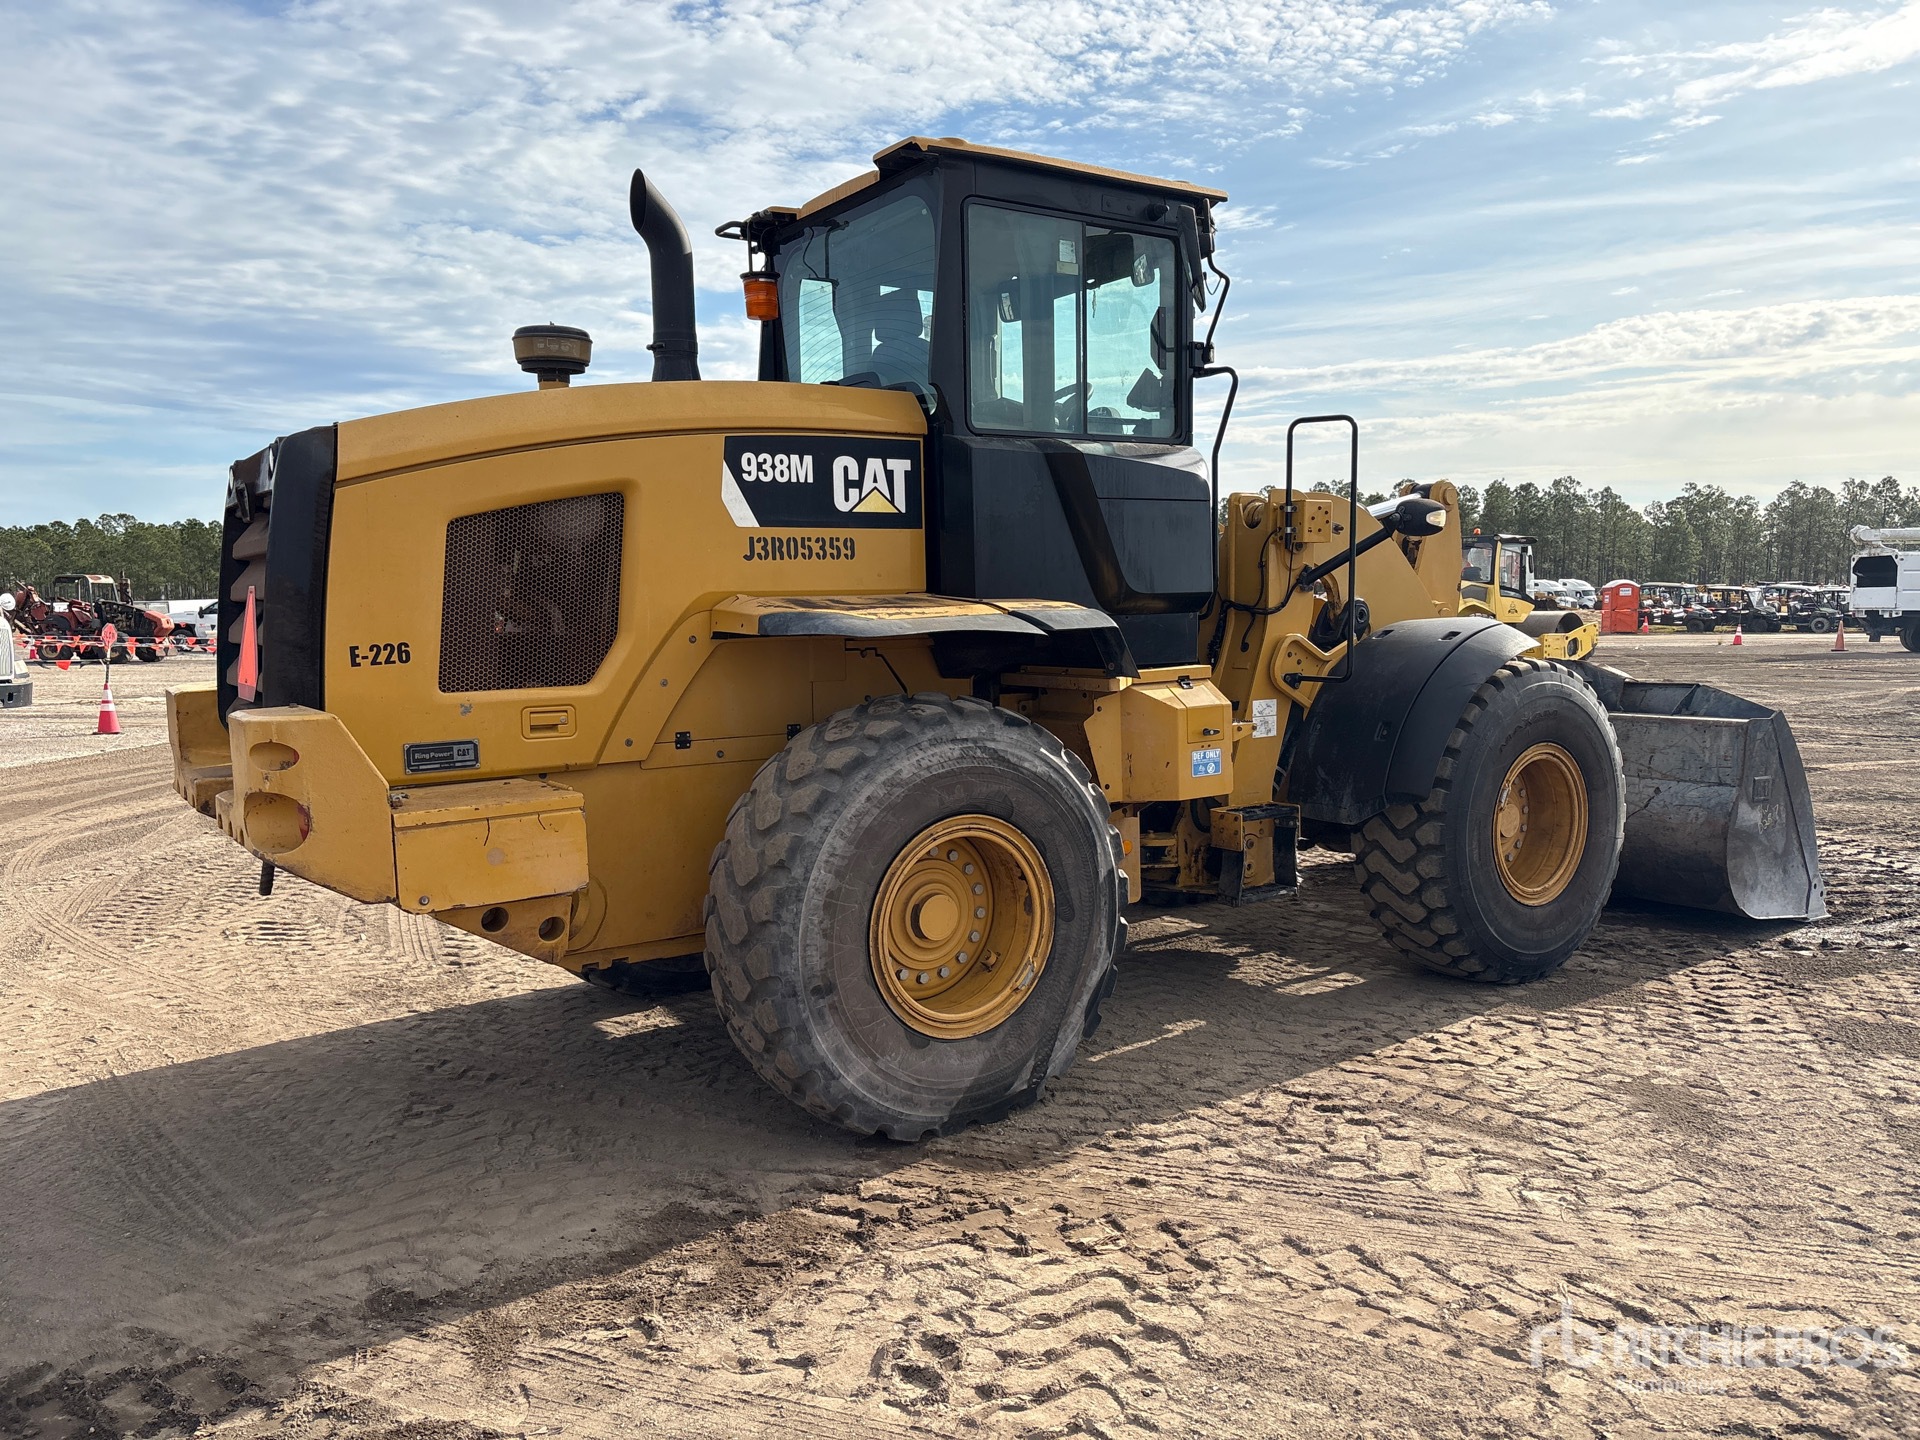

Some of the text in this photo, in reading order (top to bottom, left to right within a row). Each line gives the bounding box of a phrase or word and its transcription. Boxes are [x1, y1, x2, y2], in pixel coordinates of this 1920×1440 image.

[741, 452, 814, 483] 938M
[832, 455, 912, 514] CAT
[743, 536, 856, 561] J3R05359
[349, 642, 411, 668] E-226
[414, 752, 430, 760] Ring
[1193, 750, 1220, 760] DEF ONLY
